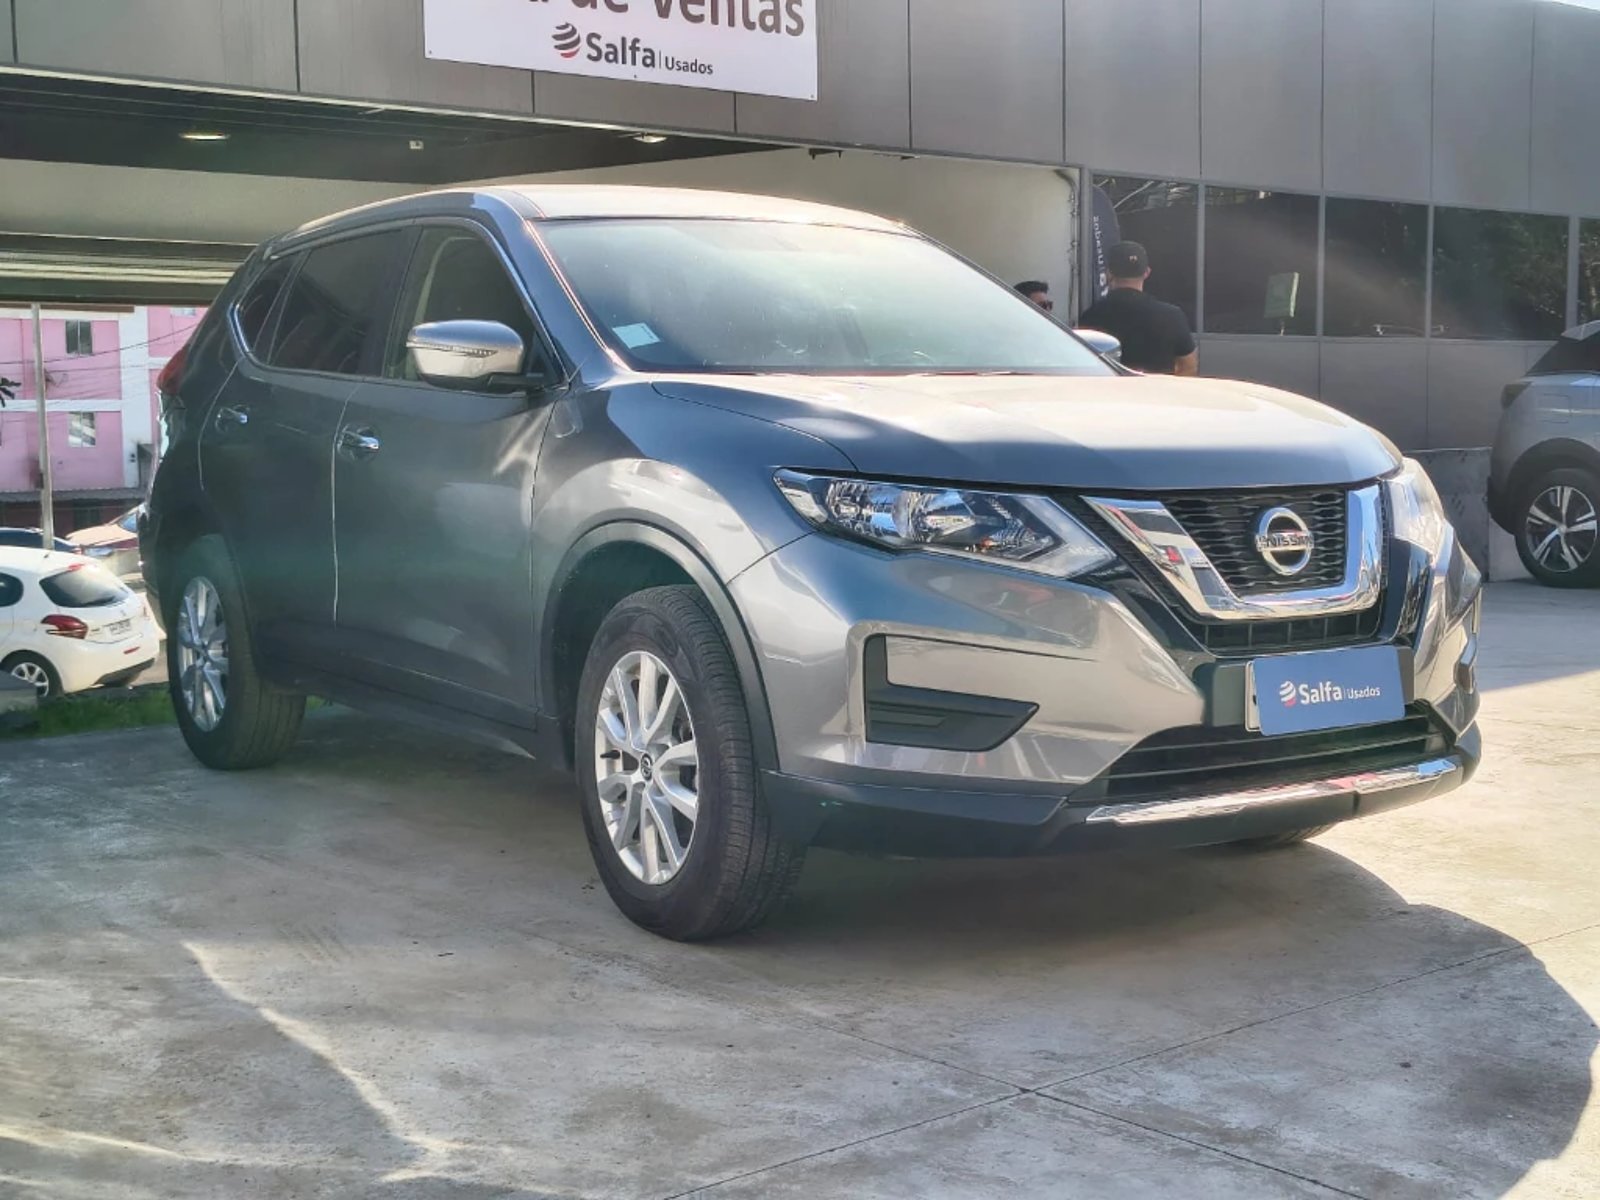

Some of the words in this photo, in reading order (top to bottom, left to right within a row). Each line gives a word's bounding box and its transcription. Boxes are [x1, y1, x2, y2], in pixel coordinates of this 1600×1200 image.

[585, 32, 656, 69] Salfa
[664, 55, 714, 76] Usados
[1298, 681, 1343, 705] Salfa
[1346, 686, 1381, 700] Usados
